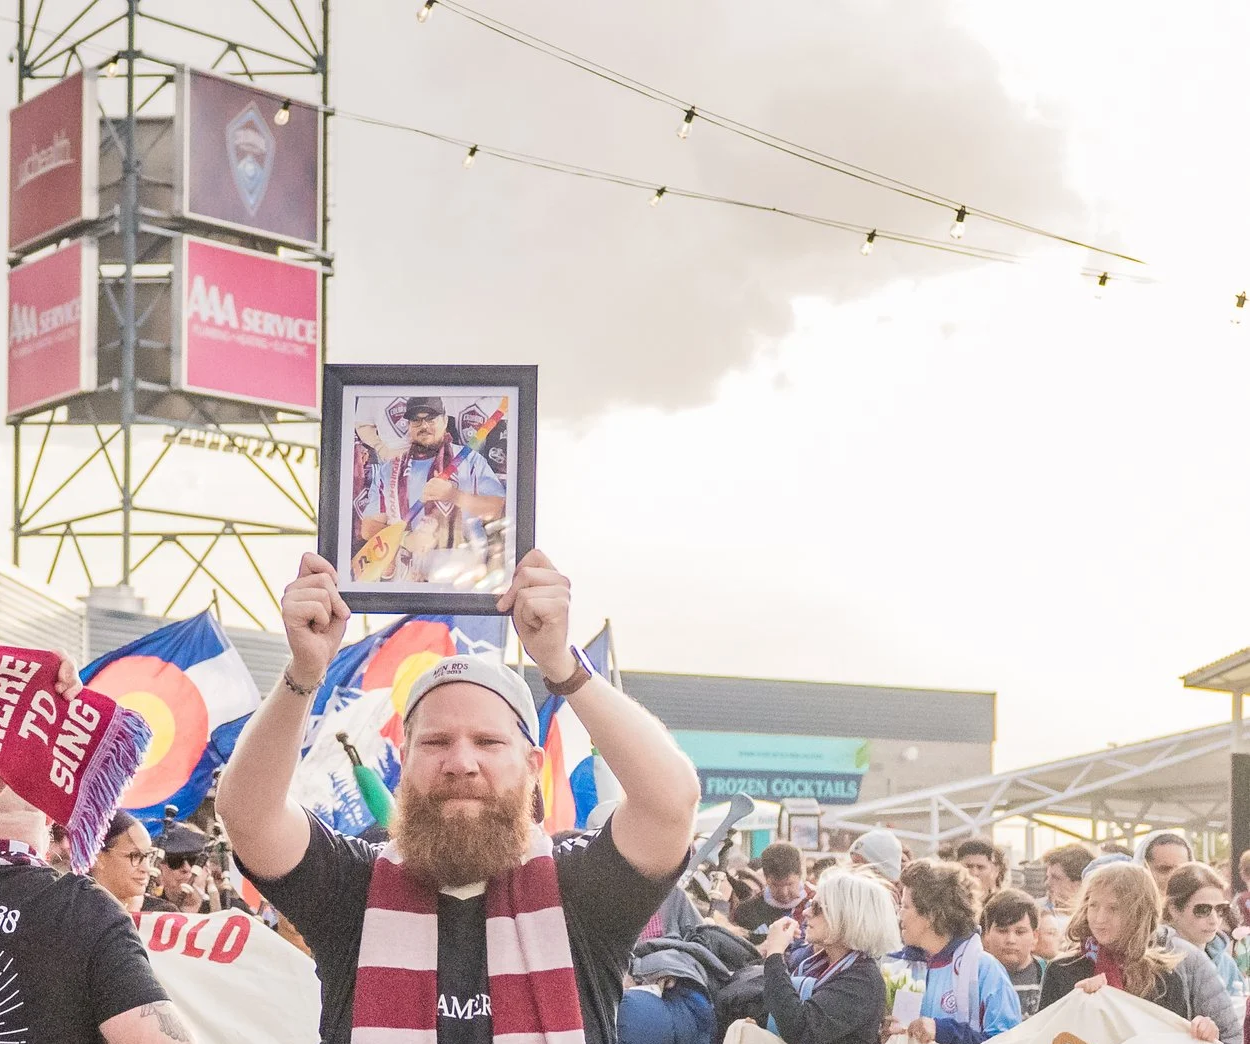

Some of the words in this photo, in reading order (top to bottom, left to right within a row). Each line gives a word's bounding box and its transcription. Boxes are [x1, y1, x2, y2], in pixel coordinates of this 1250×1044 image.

[187, 275, 239, 329] AAA
[241, 307, 317, 344] SERVICE
[18, 689, 57, 745] TO
[50, 699, 101, 795] SING
[706, 777, 768, 796] FROZEN
[772, 778, 857, 798] COCKTAILS
